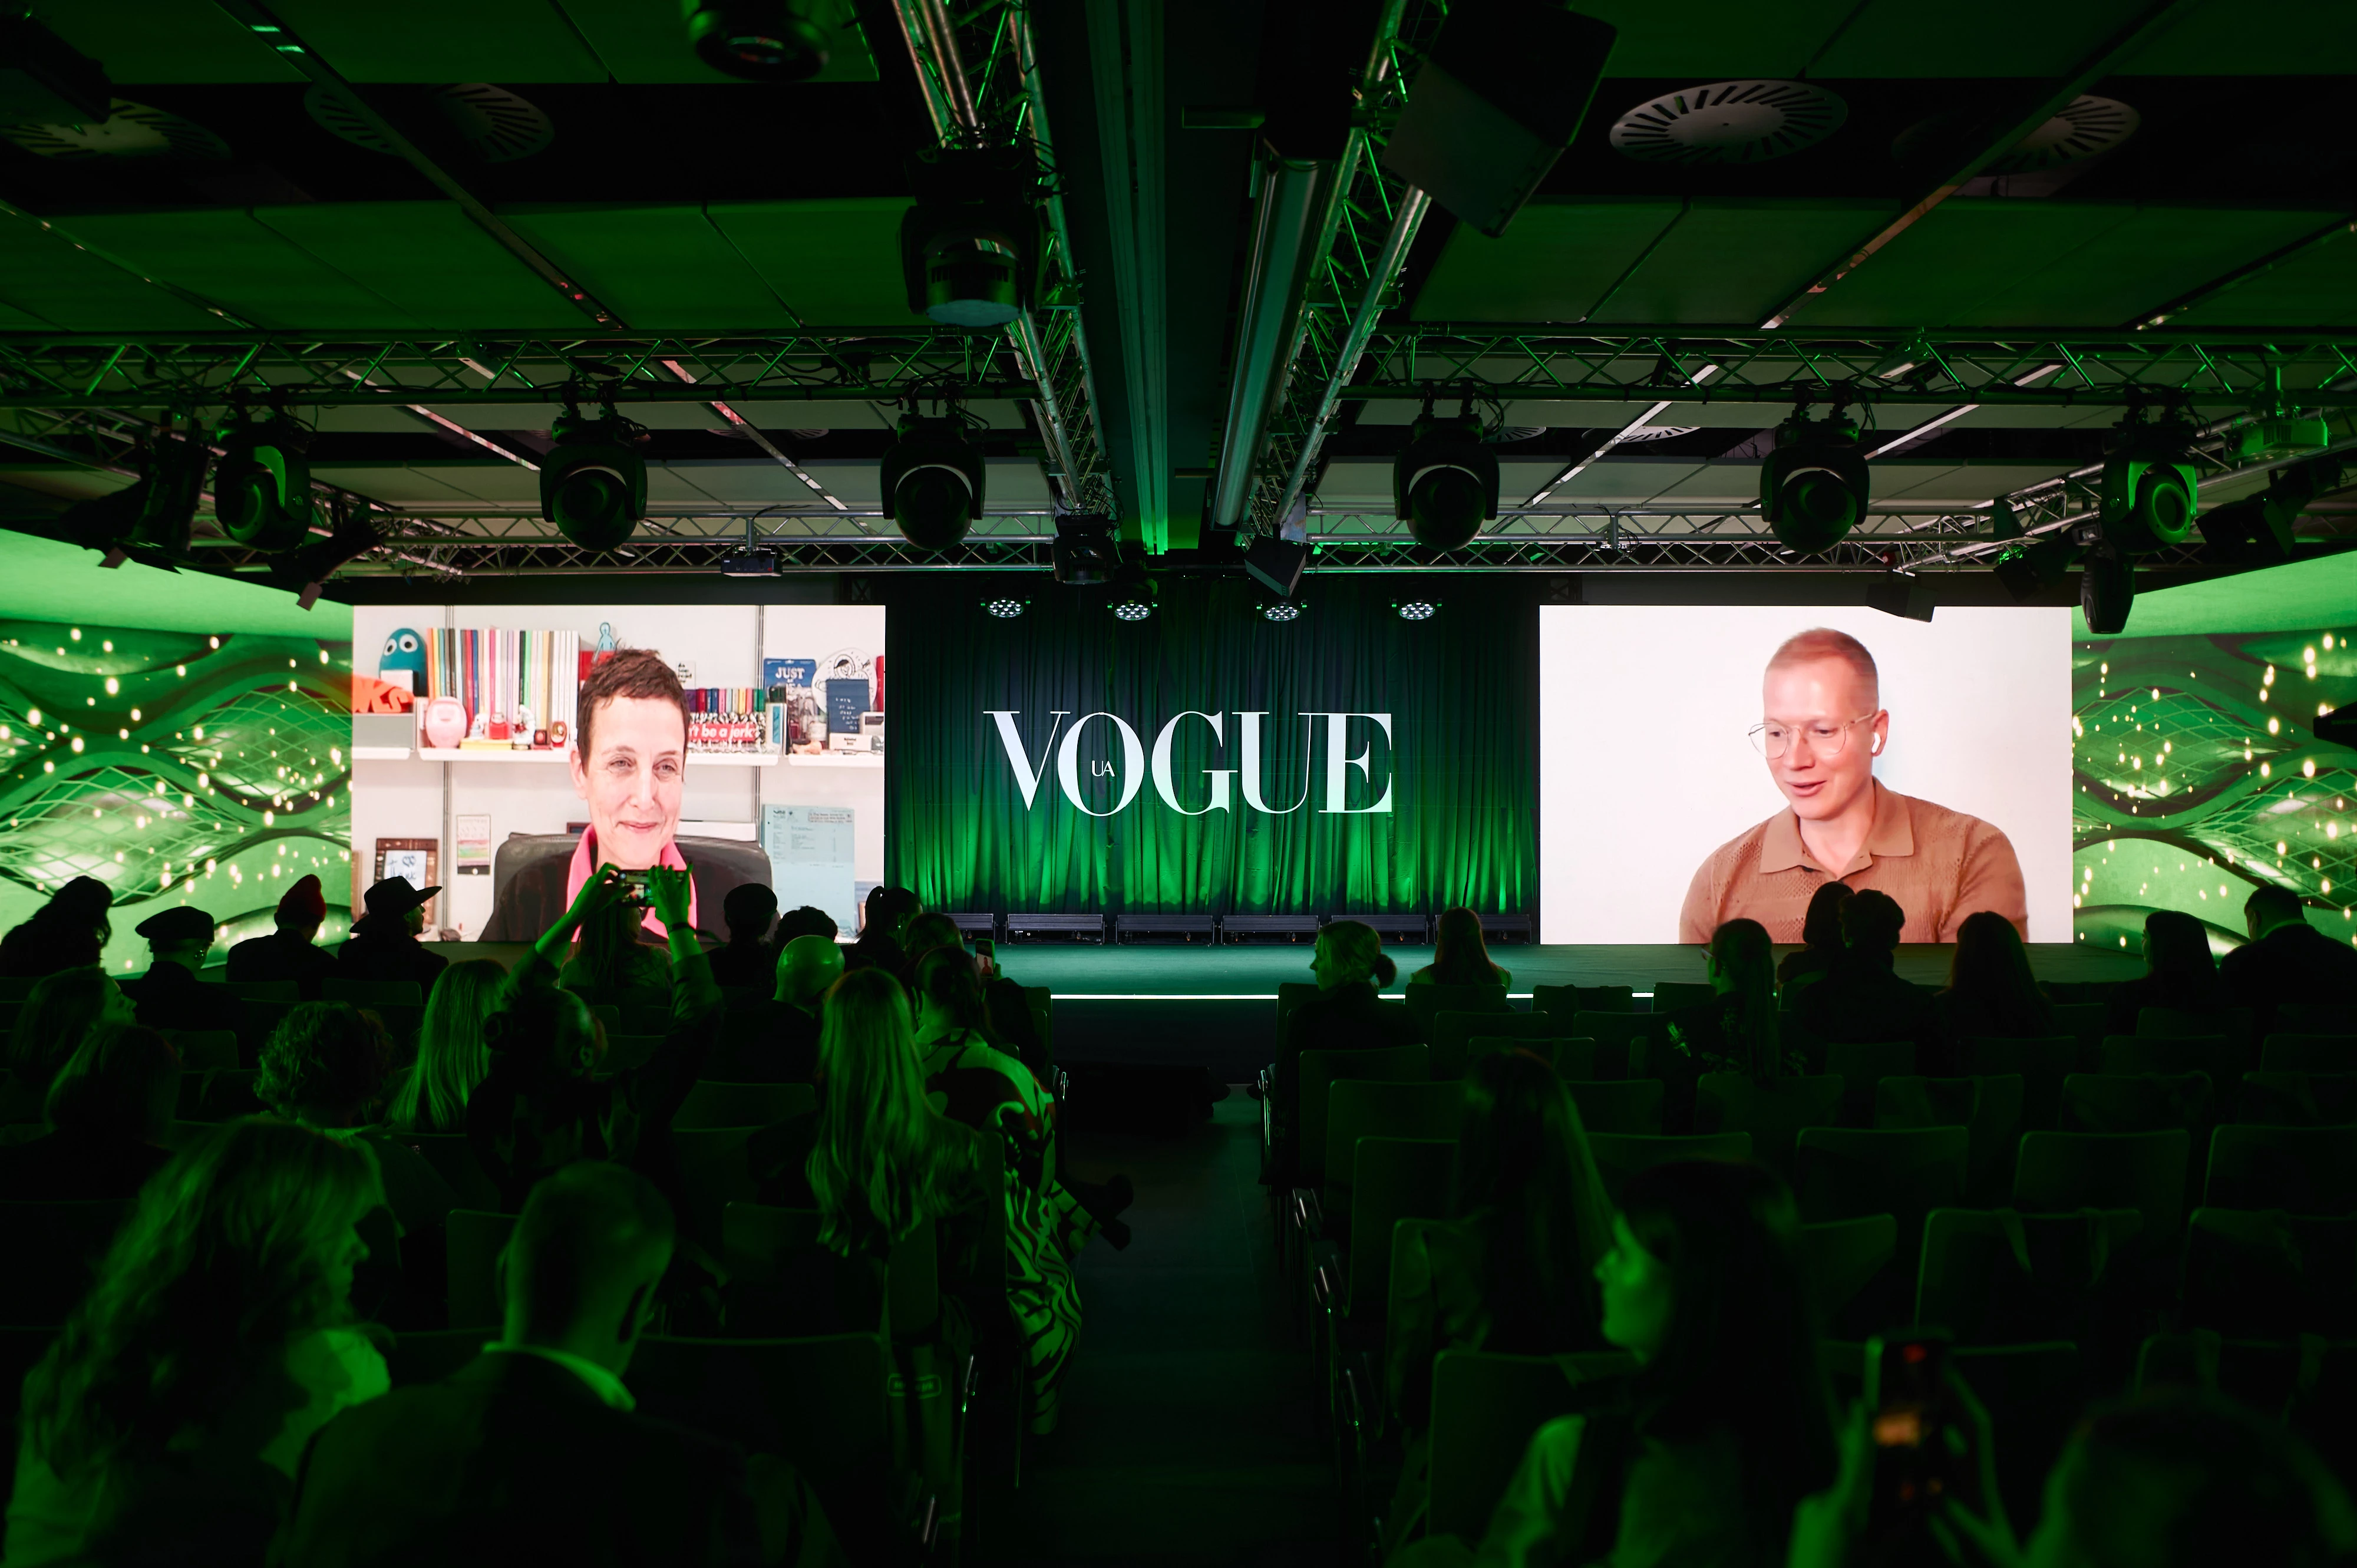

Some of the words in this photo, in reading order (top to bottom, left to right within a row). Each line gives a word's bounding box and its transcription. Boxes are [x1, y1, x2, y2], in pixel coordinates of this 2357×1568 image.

[775, 666, 805, 679] JUST
[701, 723, 717, 738] be
[718, 728, 728, 738] a
[729, 722, 755, 742] jerk
[983, 711, 1392, 817] VOGUE
[1092, 760, 1115, 777] UA
